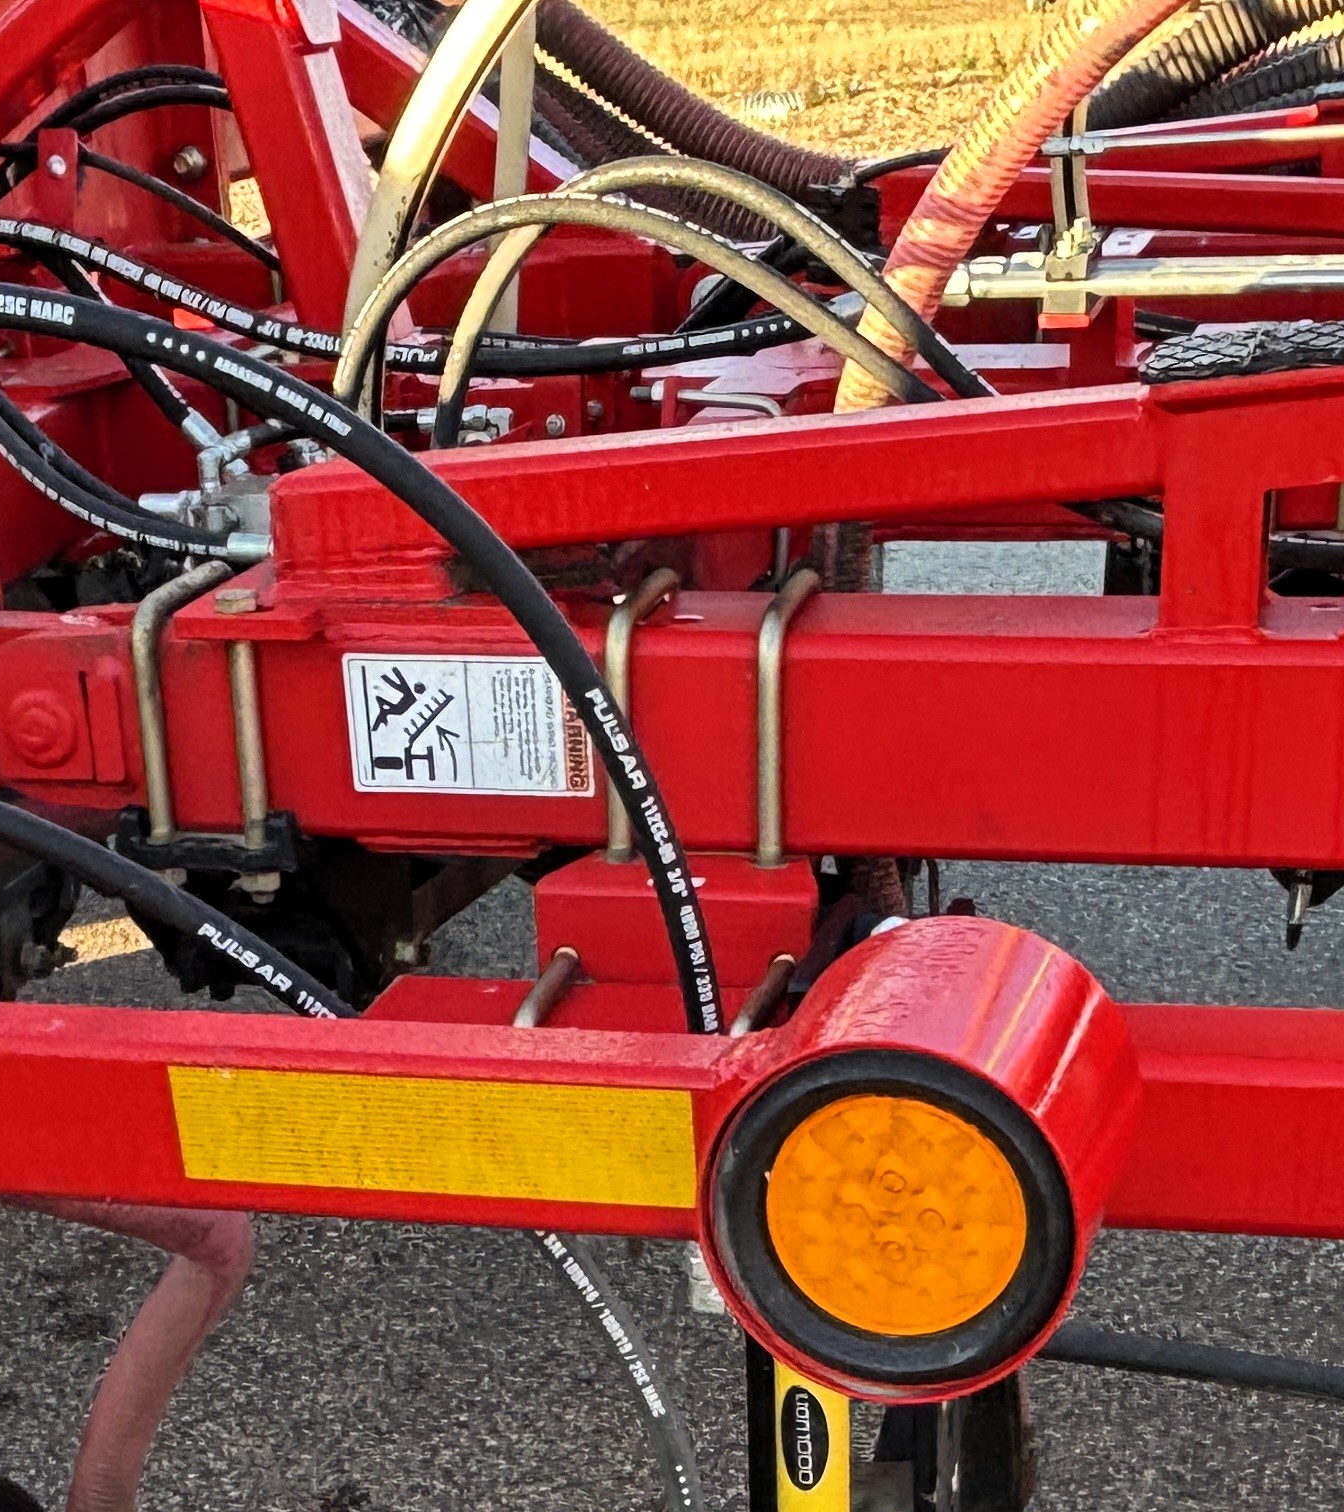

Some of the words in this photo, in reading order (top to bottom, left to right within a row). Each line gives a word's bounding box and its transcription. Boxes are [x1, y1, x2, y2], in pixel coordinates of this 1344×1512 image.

[566, 700, 589, 790] ARNING
[584, 688, 648, 790] PULSAR
[197, 922, 293, 992] PULSAR
